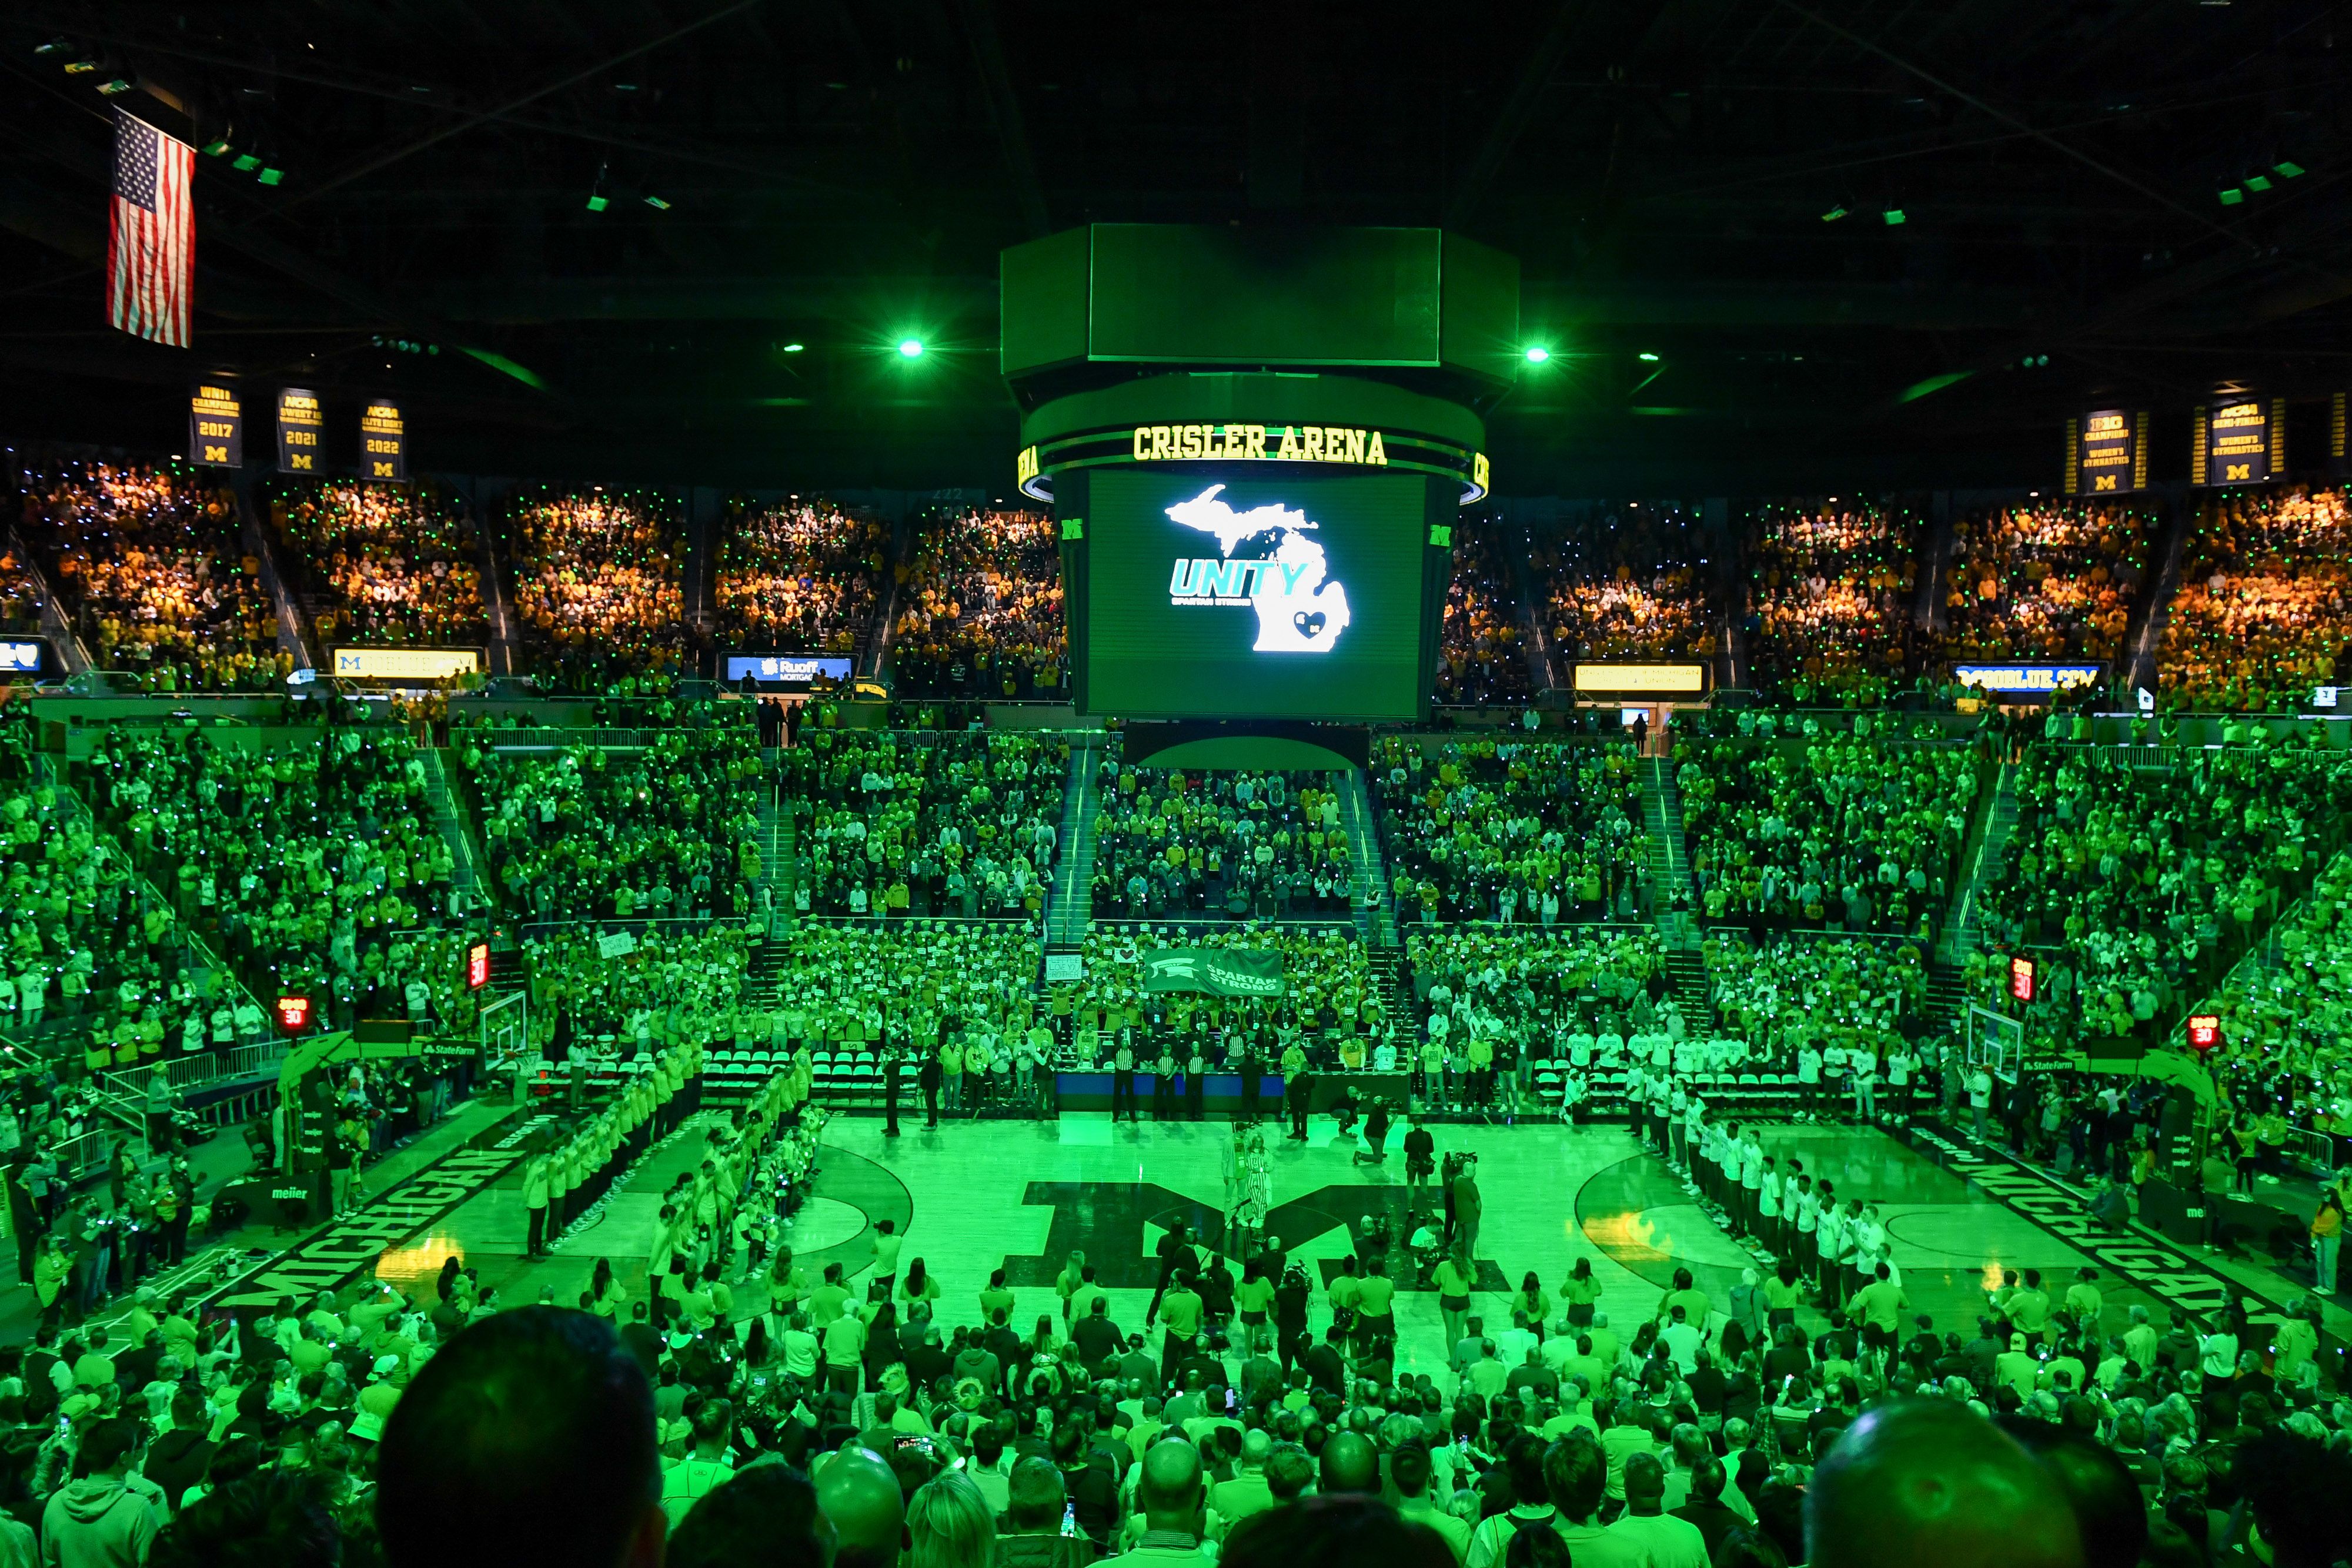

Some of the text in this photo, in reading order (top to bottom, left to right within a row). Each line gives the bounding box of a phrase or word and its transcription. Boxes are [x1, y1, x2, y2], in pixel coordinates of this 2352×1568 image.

[285, 396, 318, 409] NCAA
[368, 406, 399, 419] NCAA
[2220, 403, 2258, 418] NCAA
[199, 422, 233, 437] 2017
[2084, 429, 2129, 442] CHAMPIONS
[286, 431, 317, 446] 2021
[1134, 425, 1388, 465] CRISLER ARENA
[205, 445, 228, 462] M
[367, 439, 399, 454] 2022
[2212, 444, 2264, 456] GYMNASTICS
[292, 454, 312, 469] M
[2083, 456, 2129, 467] GYMNASTICS
[373, 462, 394, 477] M
[2226, 464, 2250, 480] M
[2095, 474, 2116, 491] M
[1061, 519, 1083, 540] M
[1429, 524, 1451, 547] M
[1170, 559, 1309, 597] UNITY
[340, 657, 360, 670] M
[780, 661, 818, 674] Ruoff
[472, 959, 486, 984] 30
[1207, 964, 1277, 985] SPARTAN
[1210, 972, 1276, 991] STRONG
[2015, 974, 2030, 999] 30
[285, 1010, 301, 1024] 30
[2196, 1028, 2212, 1041] 30
[272, 1186, 308, 1199] meijer
[215, 1150, 528, 1307] MICHIGAN
